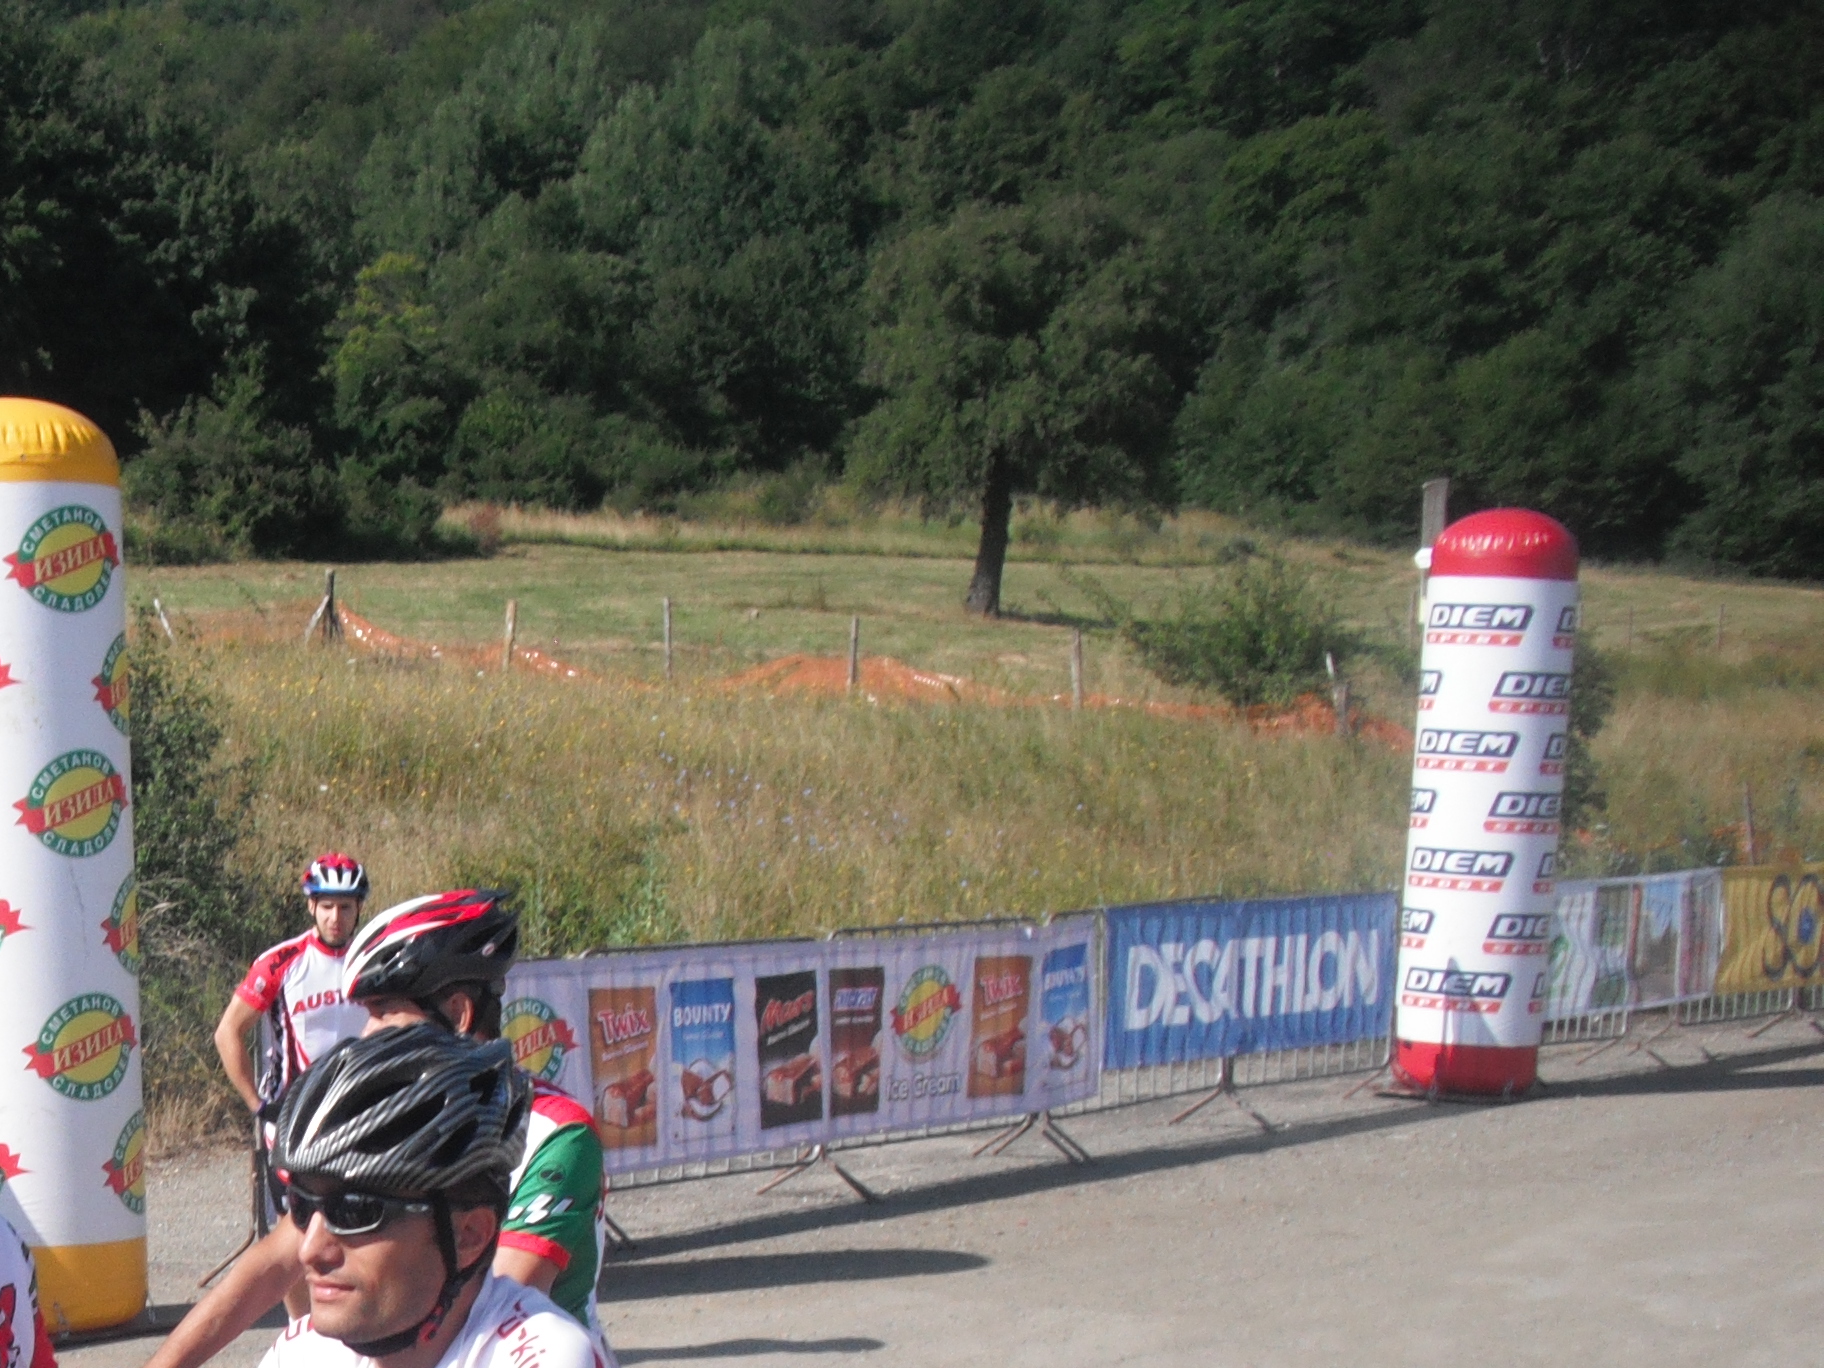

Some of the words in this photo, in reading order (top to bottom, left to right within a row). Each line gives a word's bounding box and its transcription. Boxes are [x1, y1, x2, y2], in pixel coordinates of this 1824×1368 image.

[33, 532, 107, 583] ИЗИДА
[1430, 605, 1525, 628] DIEM
[1420, 731, 1511, 756] DIEM
[43, 774, 116, 829] ИЗИДА
[1496, 795, 1561, 817] DIE
[1413, 850, 1507, 874] DIEM
[1494, 917, 1551, 937] DIE
[1126, 929, 1379, 1031] DECATHLON
[1406, 970, 1504, 995] DIEM
[597, 1002, 652, 1046] Twix
[674, 1002, 732, 1027] BOUNTY
[52, 1020, 125, 1075] ИЗИДА
